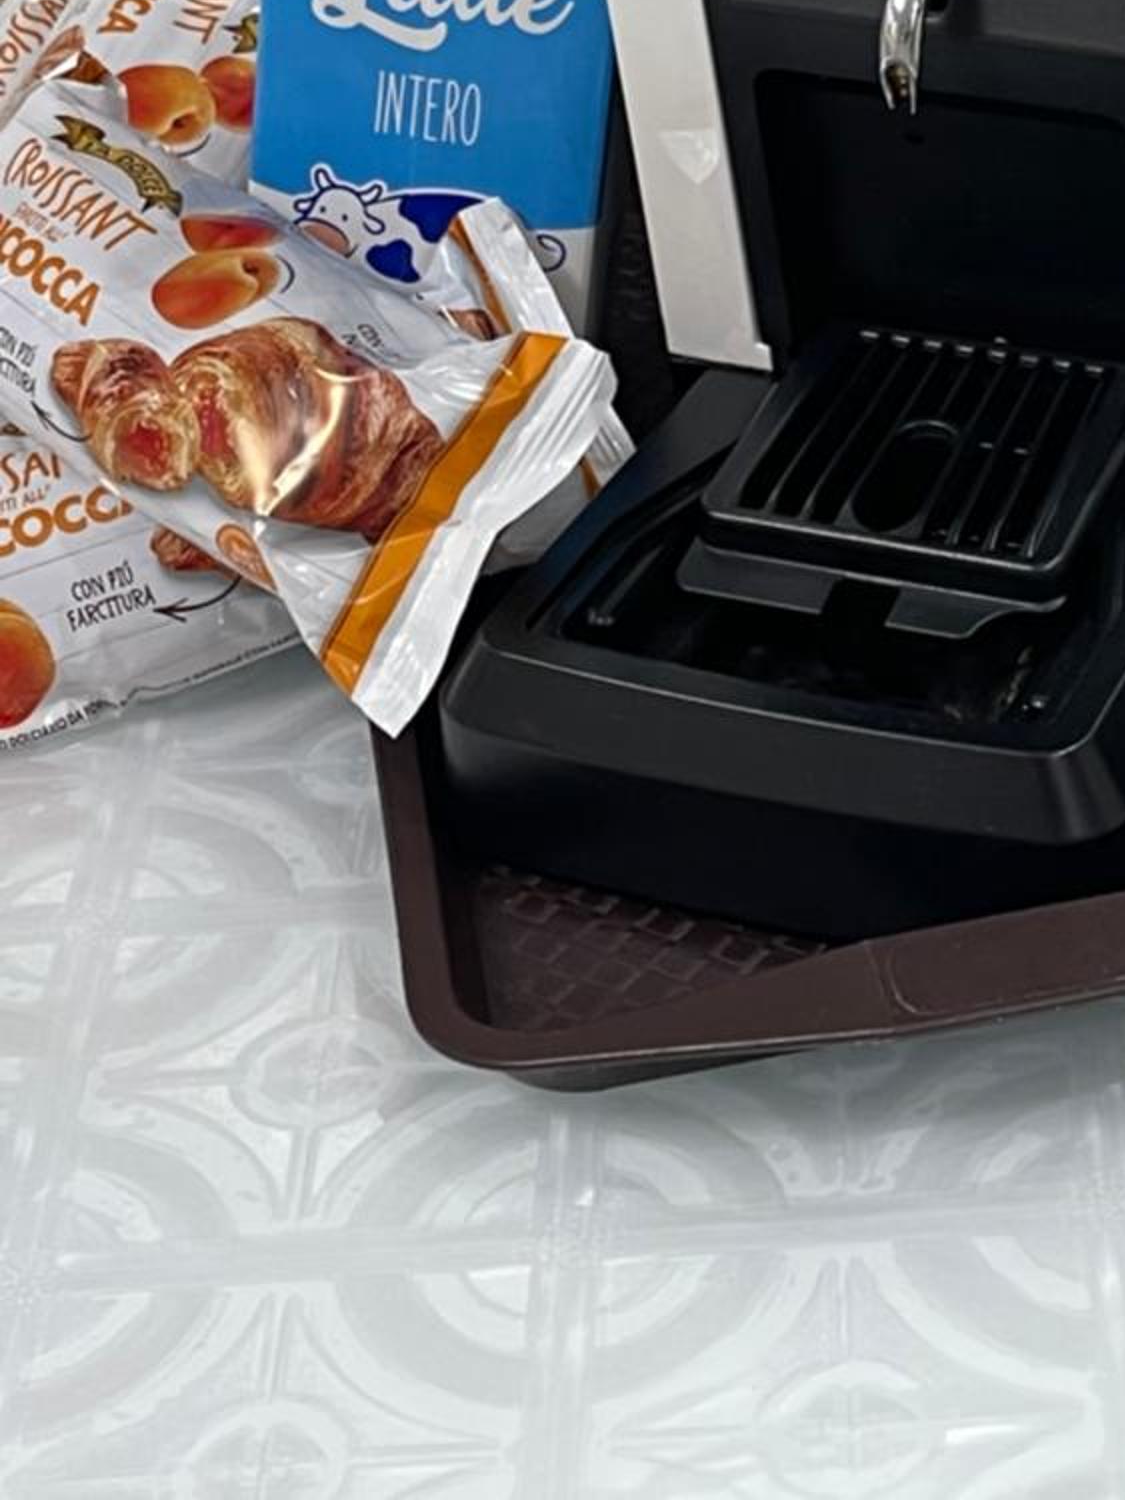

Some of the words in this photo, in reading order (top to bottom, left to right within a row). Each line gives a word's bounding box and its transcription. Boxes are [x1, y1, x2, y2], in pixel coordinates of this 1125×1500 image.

[374, 68, 483, 148] INTERO
[4, 137, 158, 251] CROISSANT
[66, 584, 157, 633] FARCITURA
